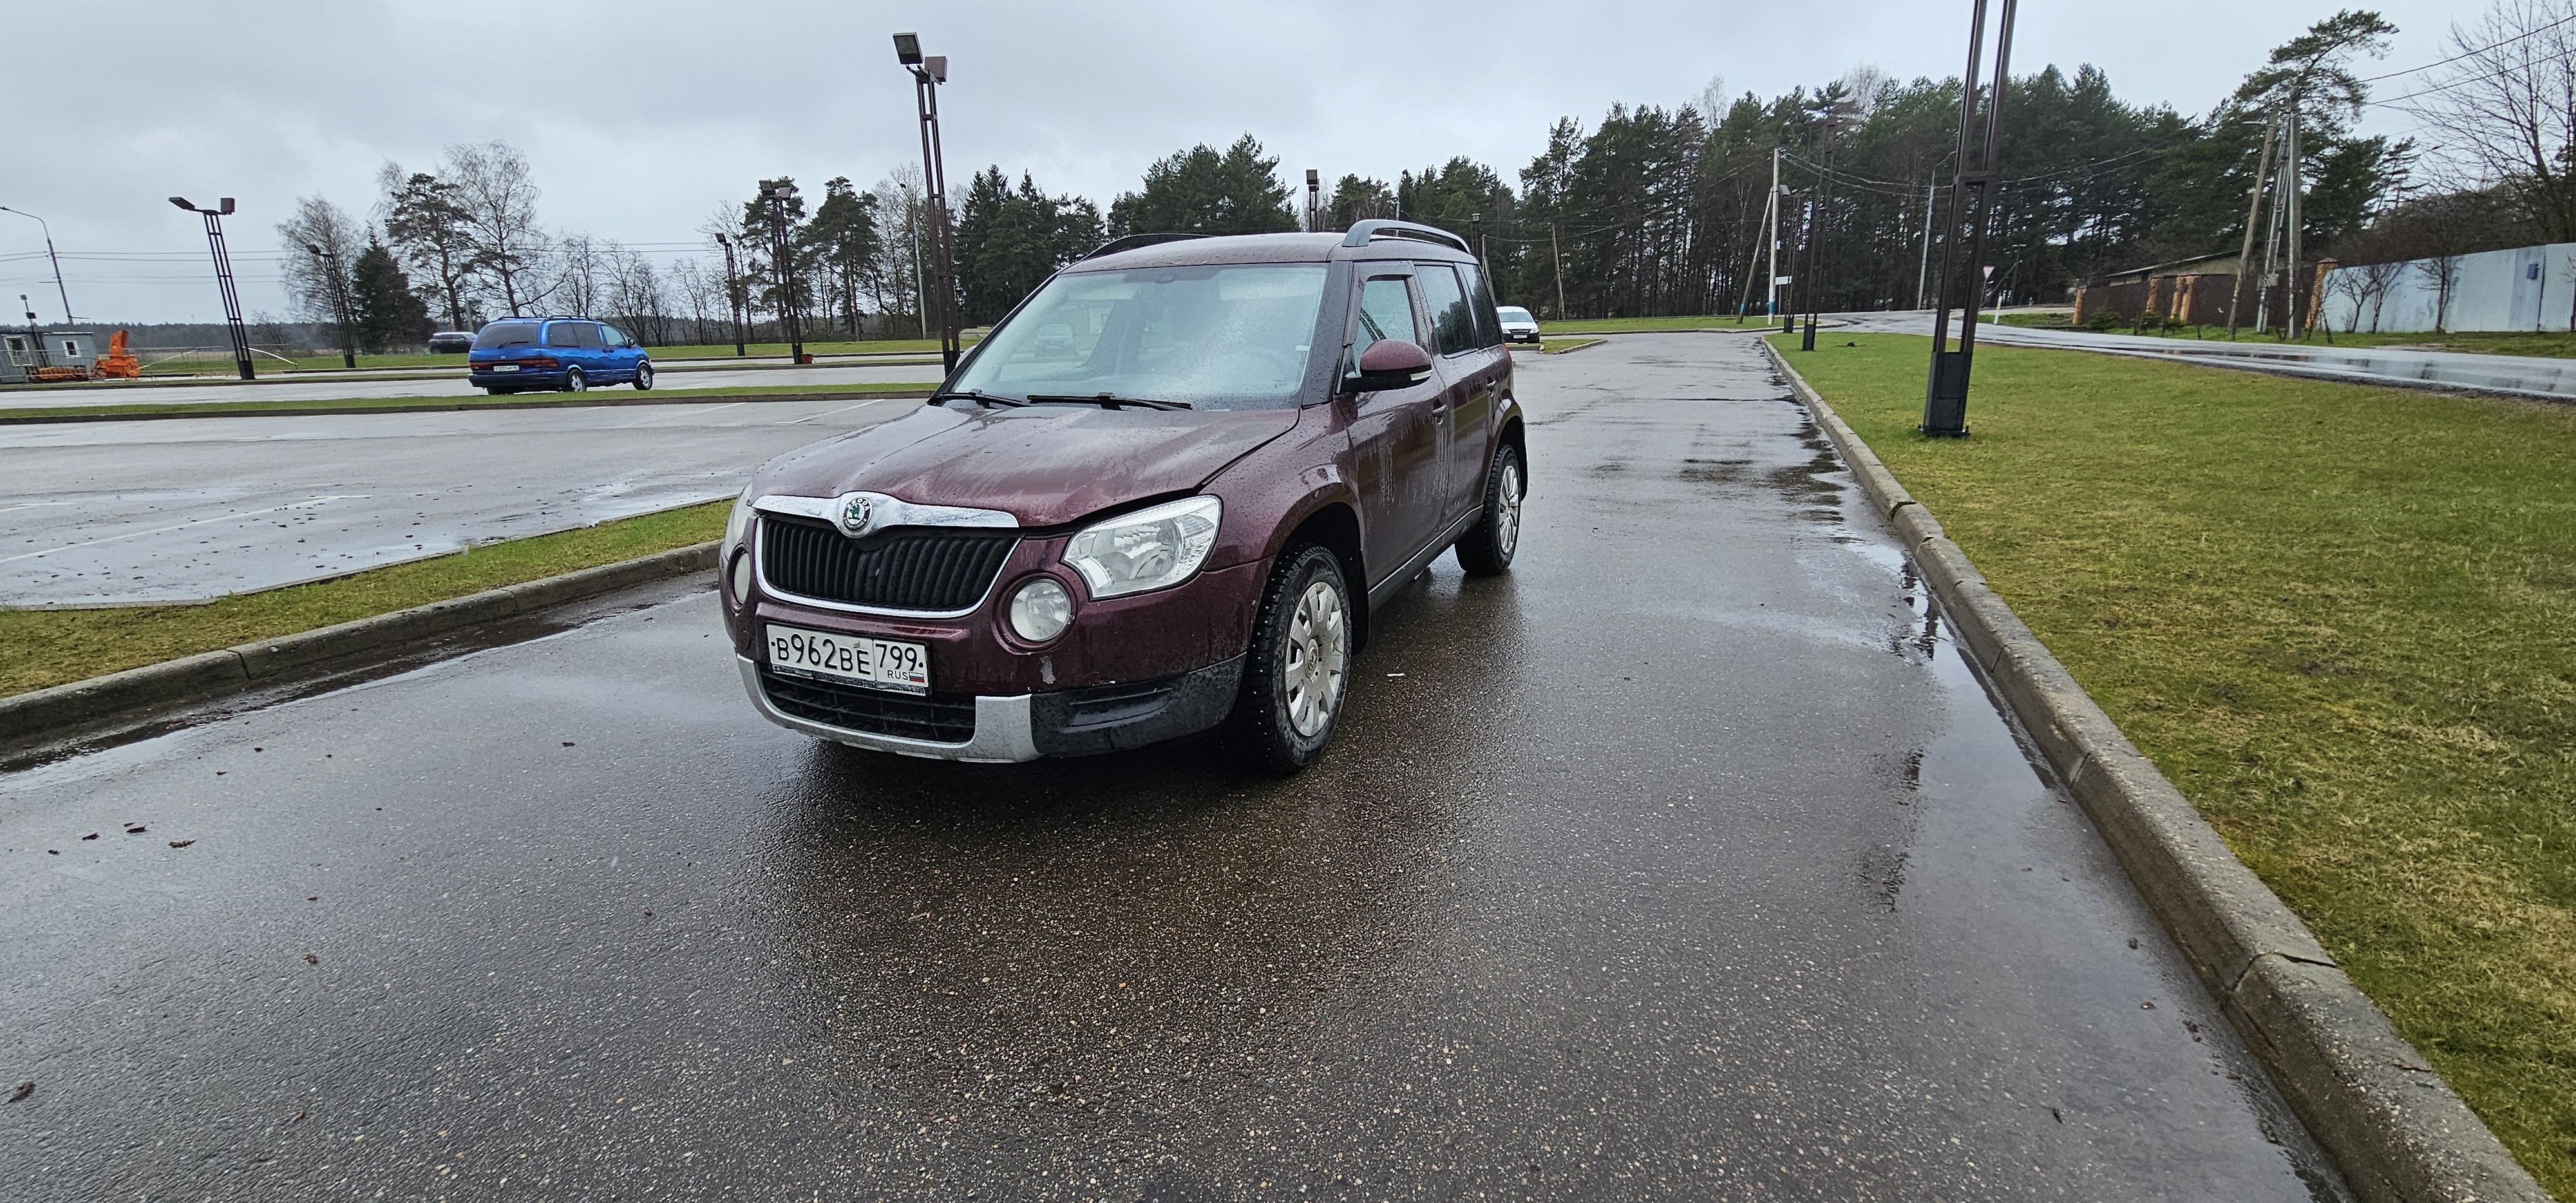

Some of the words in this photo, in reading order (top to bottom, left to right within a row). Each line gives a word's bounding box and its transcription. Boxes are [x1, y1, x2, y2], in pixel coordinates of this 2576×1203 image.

[776, 633, 871, 675] В962ВЕ
[875, 643, 918, 672] 799
[887, 670, 909, 680] RUS
